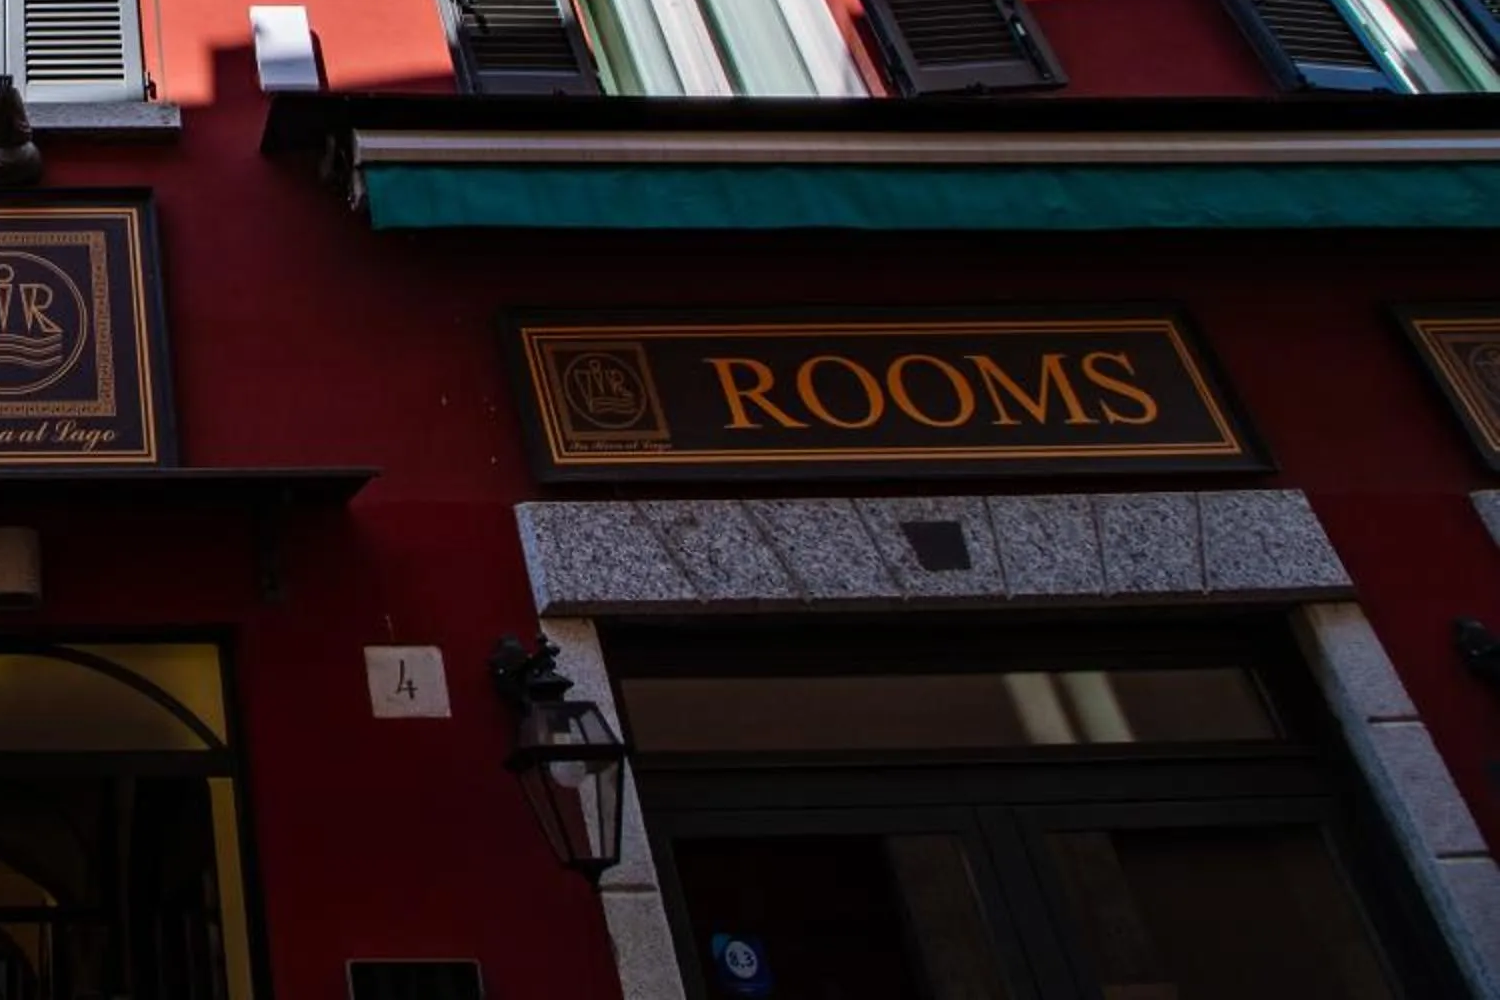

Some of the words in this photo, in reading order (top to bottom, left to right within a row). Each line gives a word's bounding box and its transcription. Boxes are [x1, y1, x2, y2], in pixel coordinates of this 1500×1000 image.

[700, 348, 1158, 430] ROOMS
[17, 420, 49, 443] al
[51, 418, 117, 455] Lago
[394, 659, 418, 700] 4
